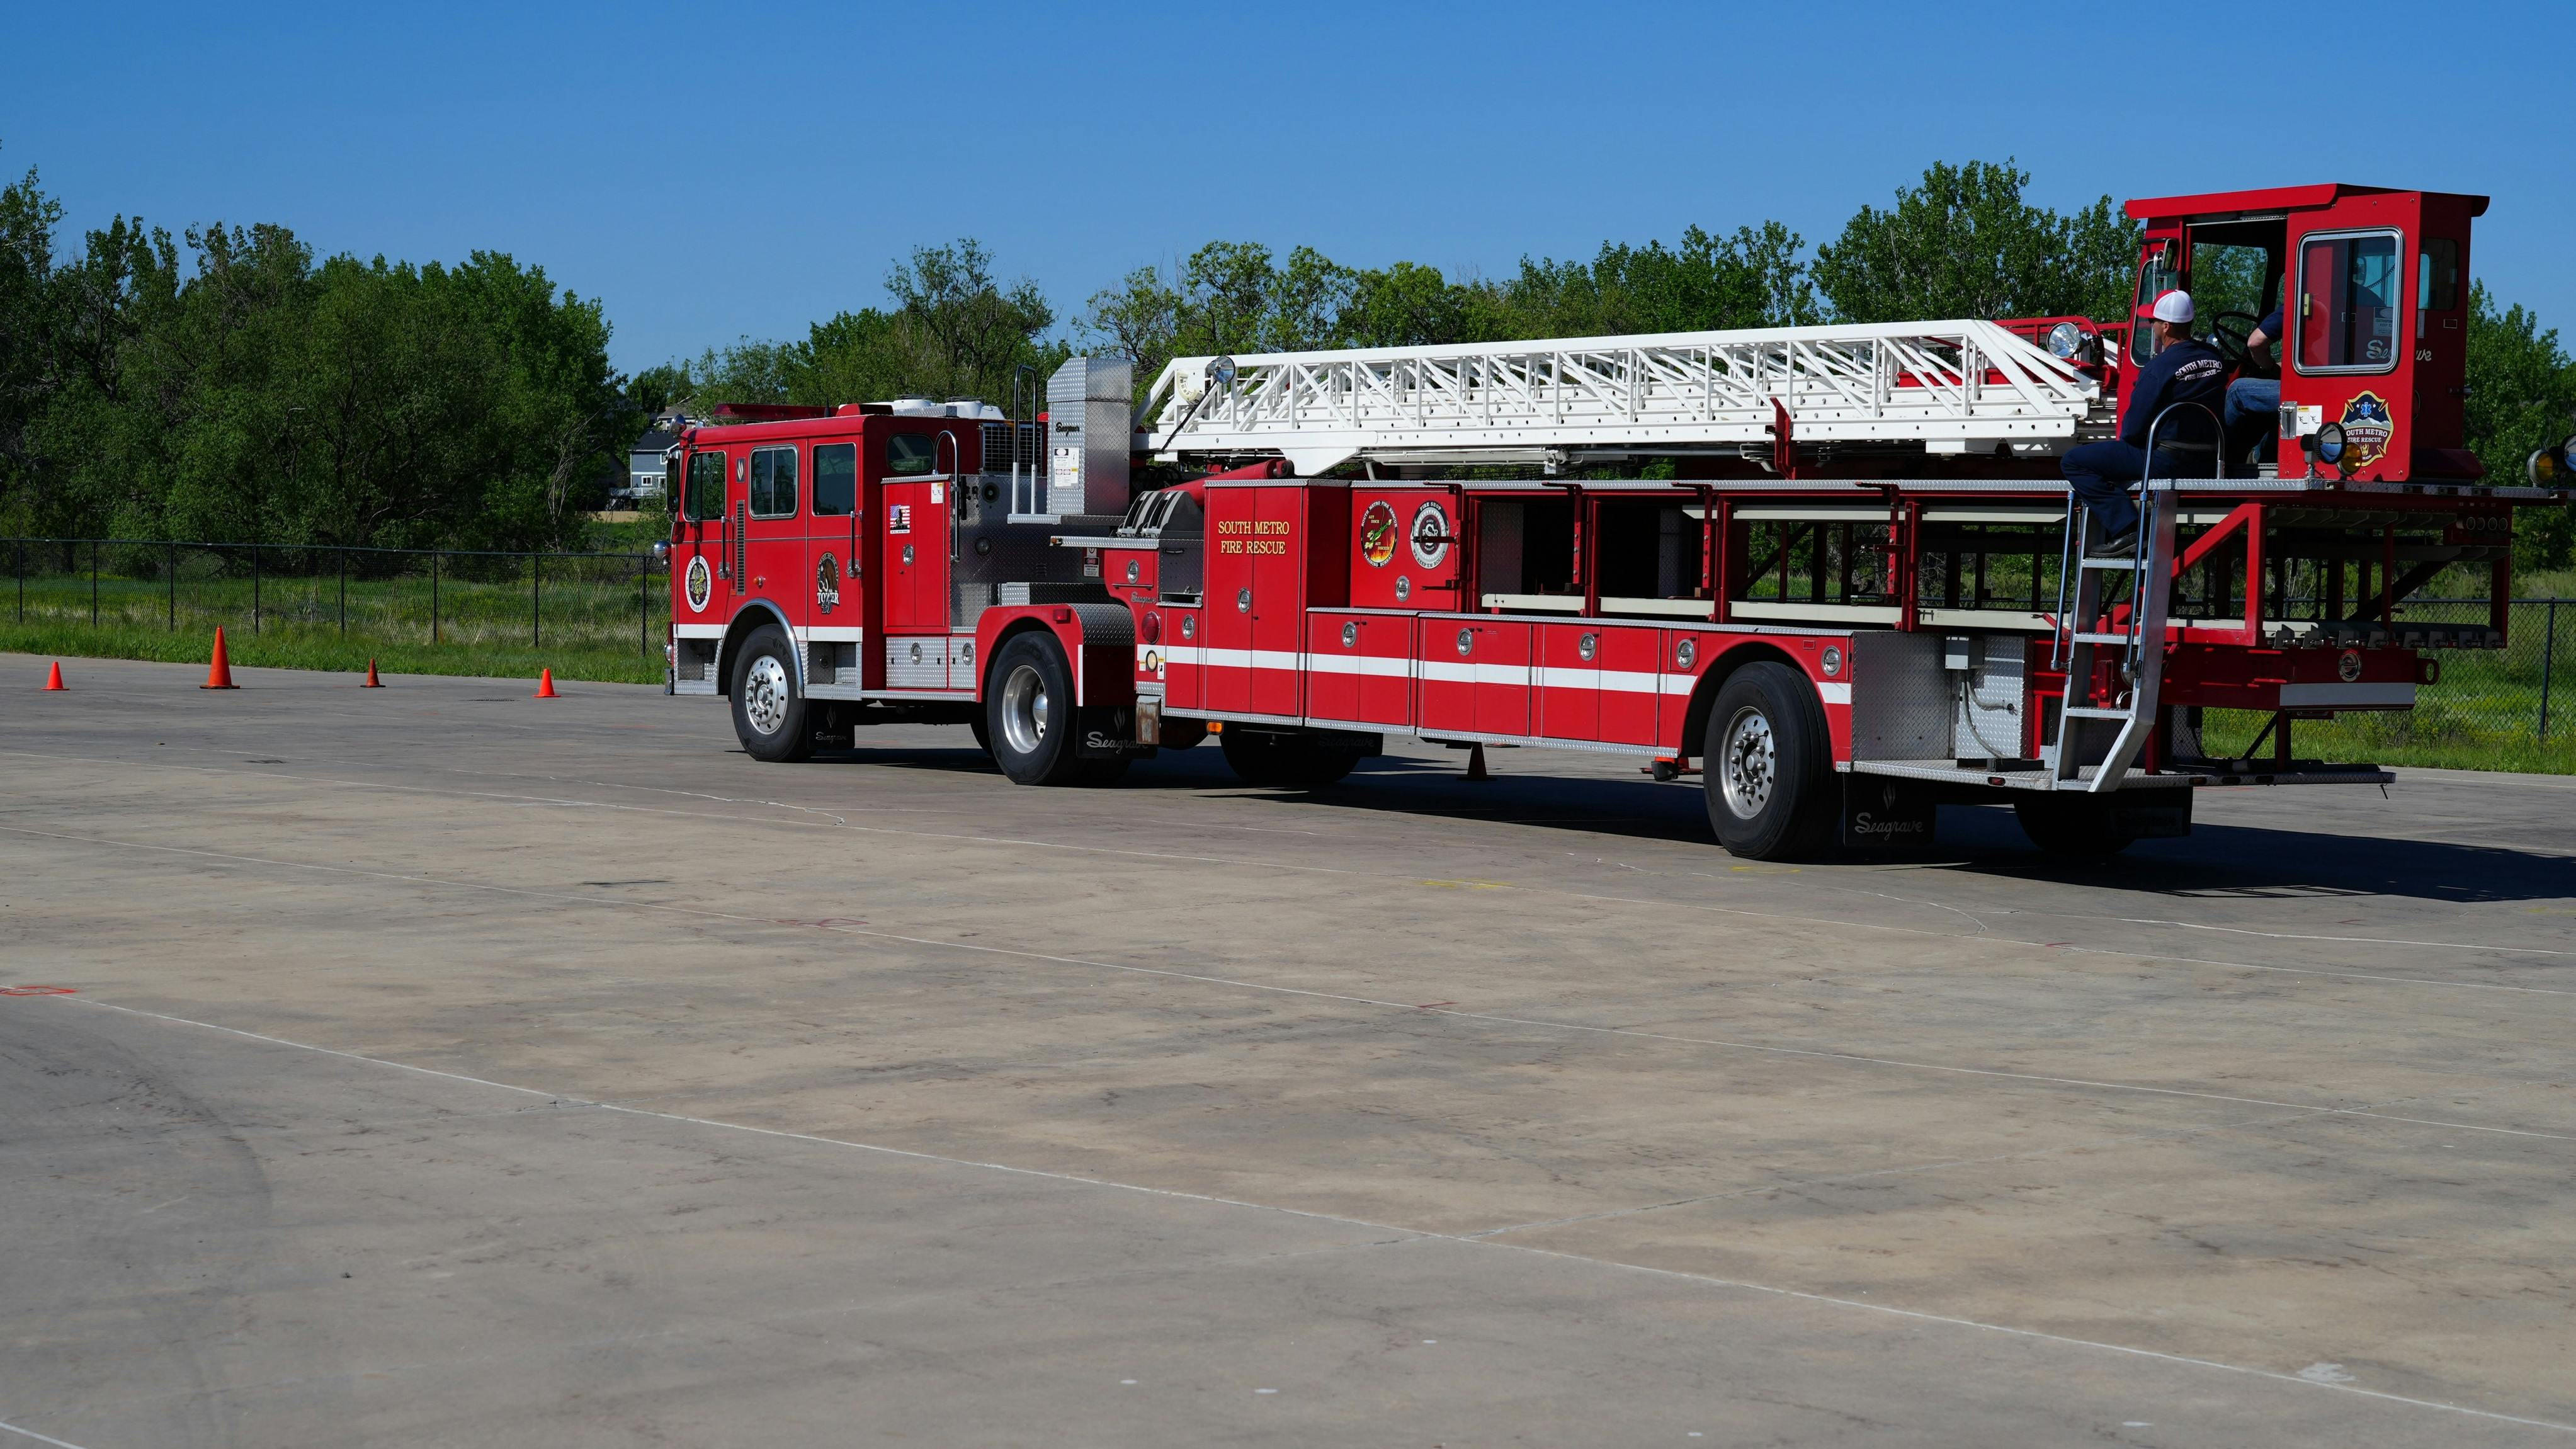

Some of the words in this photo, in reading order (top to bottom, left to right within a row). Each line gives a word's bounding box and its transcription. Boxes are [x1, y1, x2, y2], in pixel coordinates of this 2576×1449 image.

[2366, 339, 2432, 361] Seve
[2175, 361, 2198, 380] SOUTH
[2197, 360, 2223, 369] METRO
[2196, 369, 2217, 378] RESCUE
[2365, 429, 2388, 437] METRO
[1420, 502, 1429, 511] FIRE
[1431, 501, 1441, 511] SHOP
[1361, 509, 1370, 527] SOUTH
[1369, 501, 1381, 511] METRO
[1381, 501, 1390, 509] FIRE
[1389, 508, 1398, 527] RESCUE
[1218, 521, 1252, 534] SOUTH
[1254, 521, 1290, 535] METRO
[1220, 540, 1243, 554] FIRE
[1245, 540, 1286, 554] RESCUE
[1363, 552, 1378, 567] TRAINING
[1854, 812, 1924, 841] Seagrave
